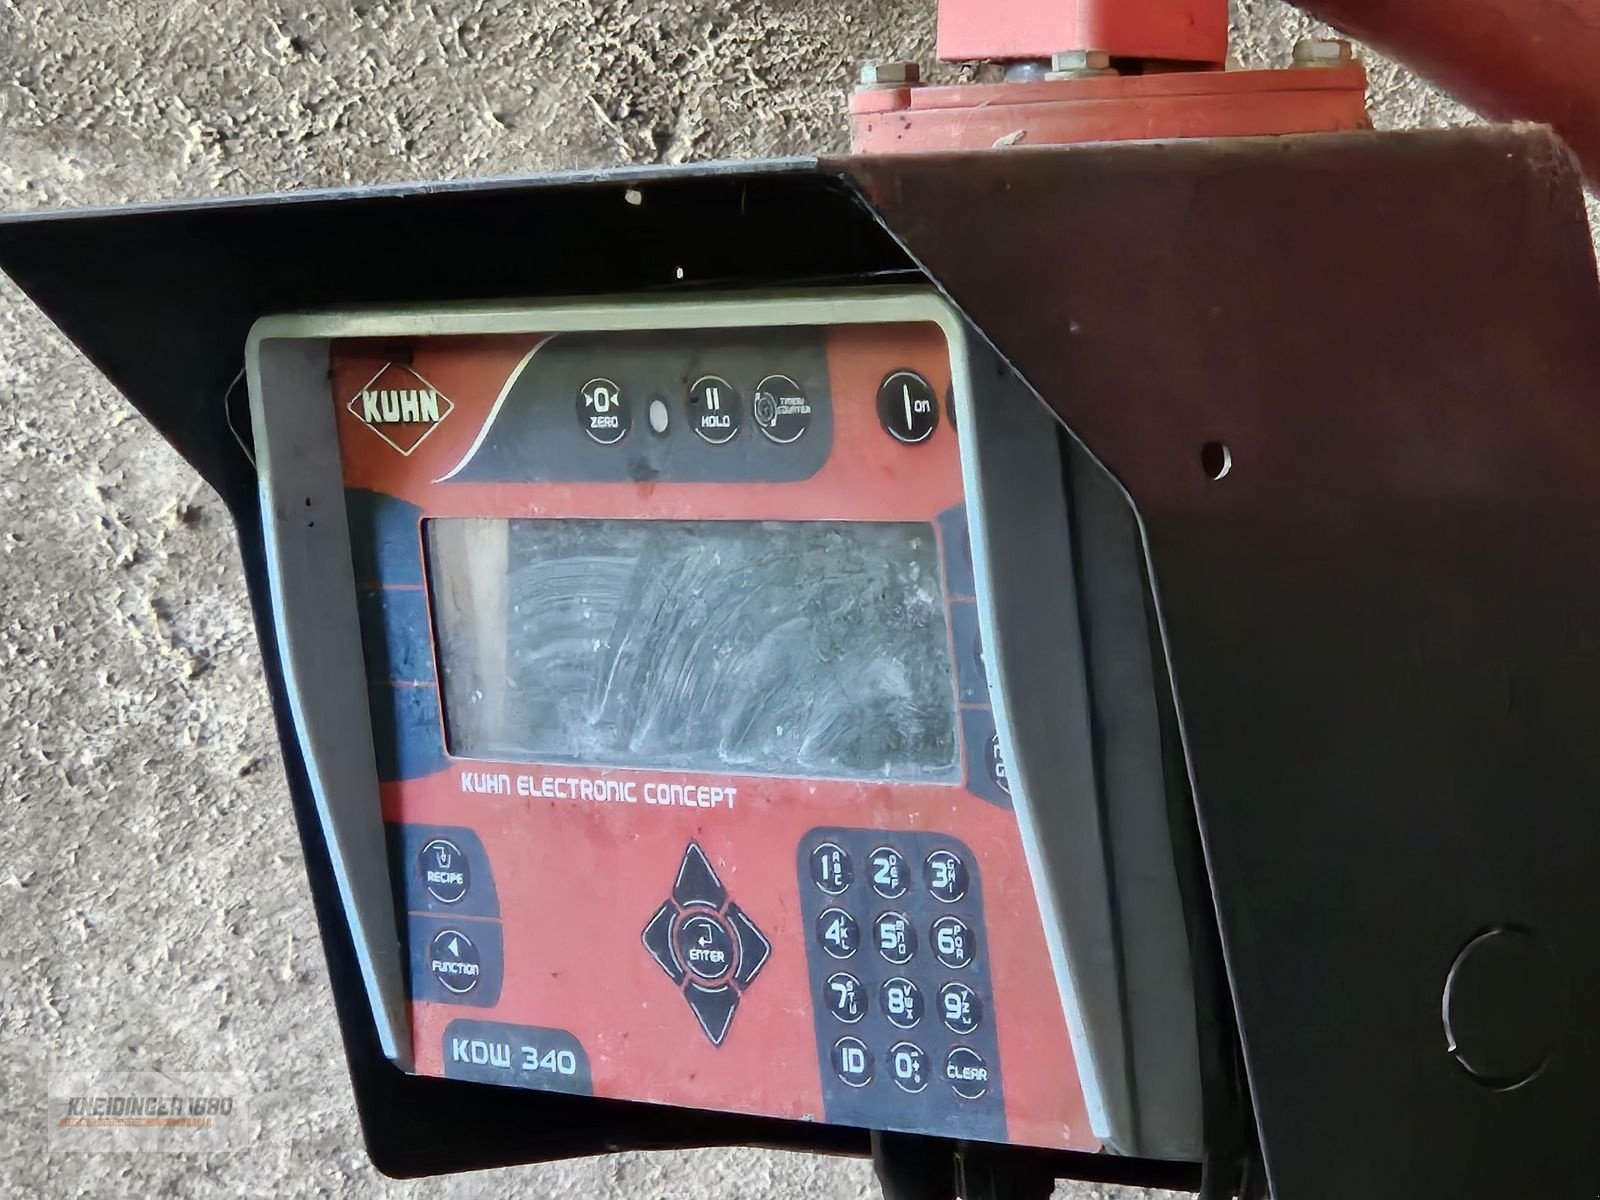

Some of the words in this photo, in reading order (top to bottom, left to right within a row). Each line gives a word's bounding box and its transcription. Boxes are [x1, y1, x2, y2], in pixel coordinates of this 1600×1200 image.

[362, 388, 440, 423] KUHN
[590, 416, 618, 428] ZERO
[701, 416, 730, 428] HOLD
[461, 772, 510, 795] KUHN
[516, 775, 637, 802] ELECTRONIC
[643, 783, 737, 808] CONCEPT
[427, 871, 464, 884] RECIPE
[821, 855, 829, 880] 1
[873, 858, 891, 884] 2
[931, 862, 948, 887] 3
[824, 919, 841, 945] 4
[880, 923, 897, 949] 5
[937, 928, 955, 954] 6
[432, 960, 479, 976] FUNCTION
[689, 949, 725, 962] ENTER
[831, 982, 847, 1009] 7
[888, 988, 905, 1014] 8
[944, 992, 962, 1019] 9
[453, 1038, 511, 1068] KDW
[520, 1046, 577, 1075] 340
[842, 1047, 865, 1073] ID
[895, 1052, 912, 1079] 0
[947, 1063, 988, 1081] CLEAR
